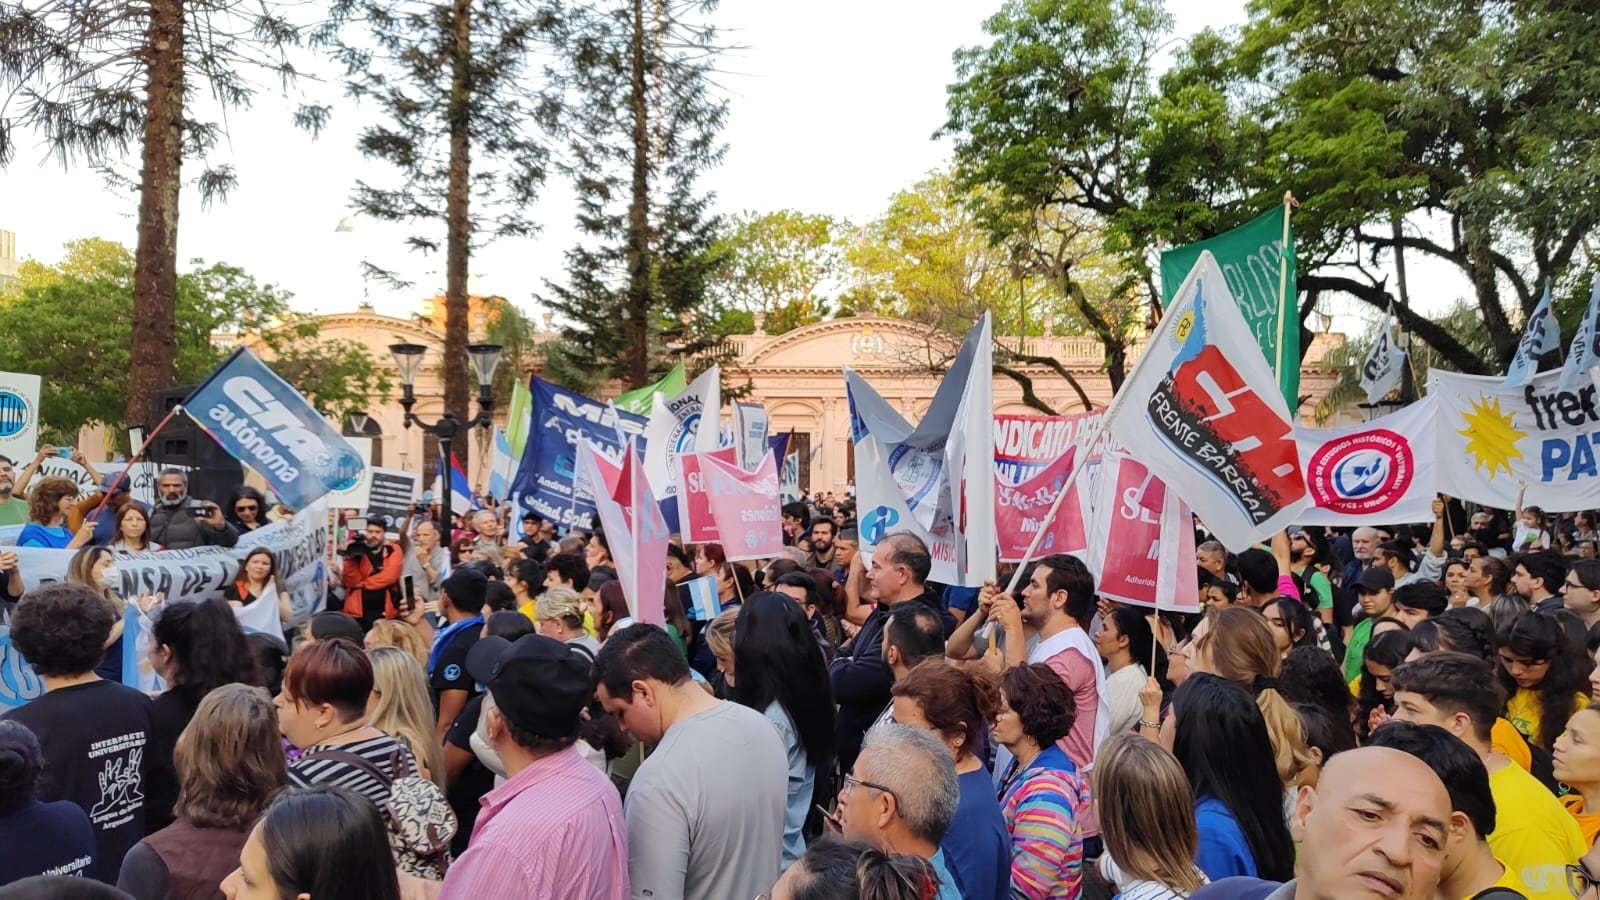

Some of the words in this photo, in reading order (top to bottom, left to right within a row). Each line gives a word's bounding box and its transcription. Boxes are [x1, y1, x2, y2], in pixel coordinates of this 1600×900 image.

[208, 403, 299, 484] autónoma
[222, 375, 327, 463] CTA
[1150, 391, 1200, 448] FRENTE
[1195, 441, 1267, 523] BARRIAL
[1124, 574, 1156, 586] Adherido
